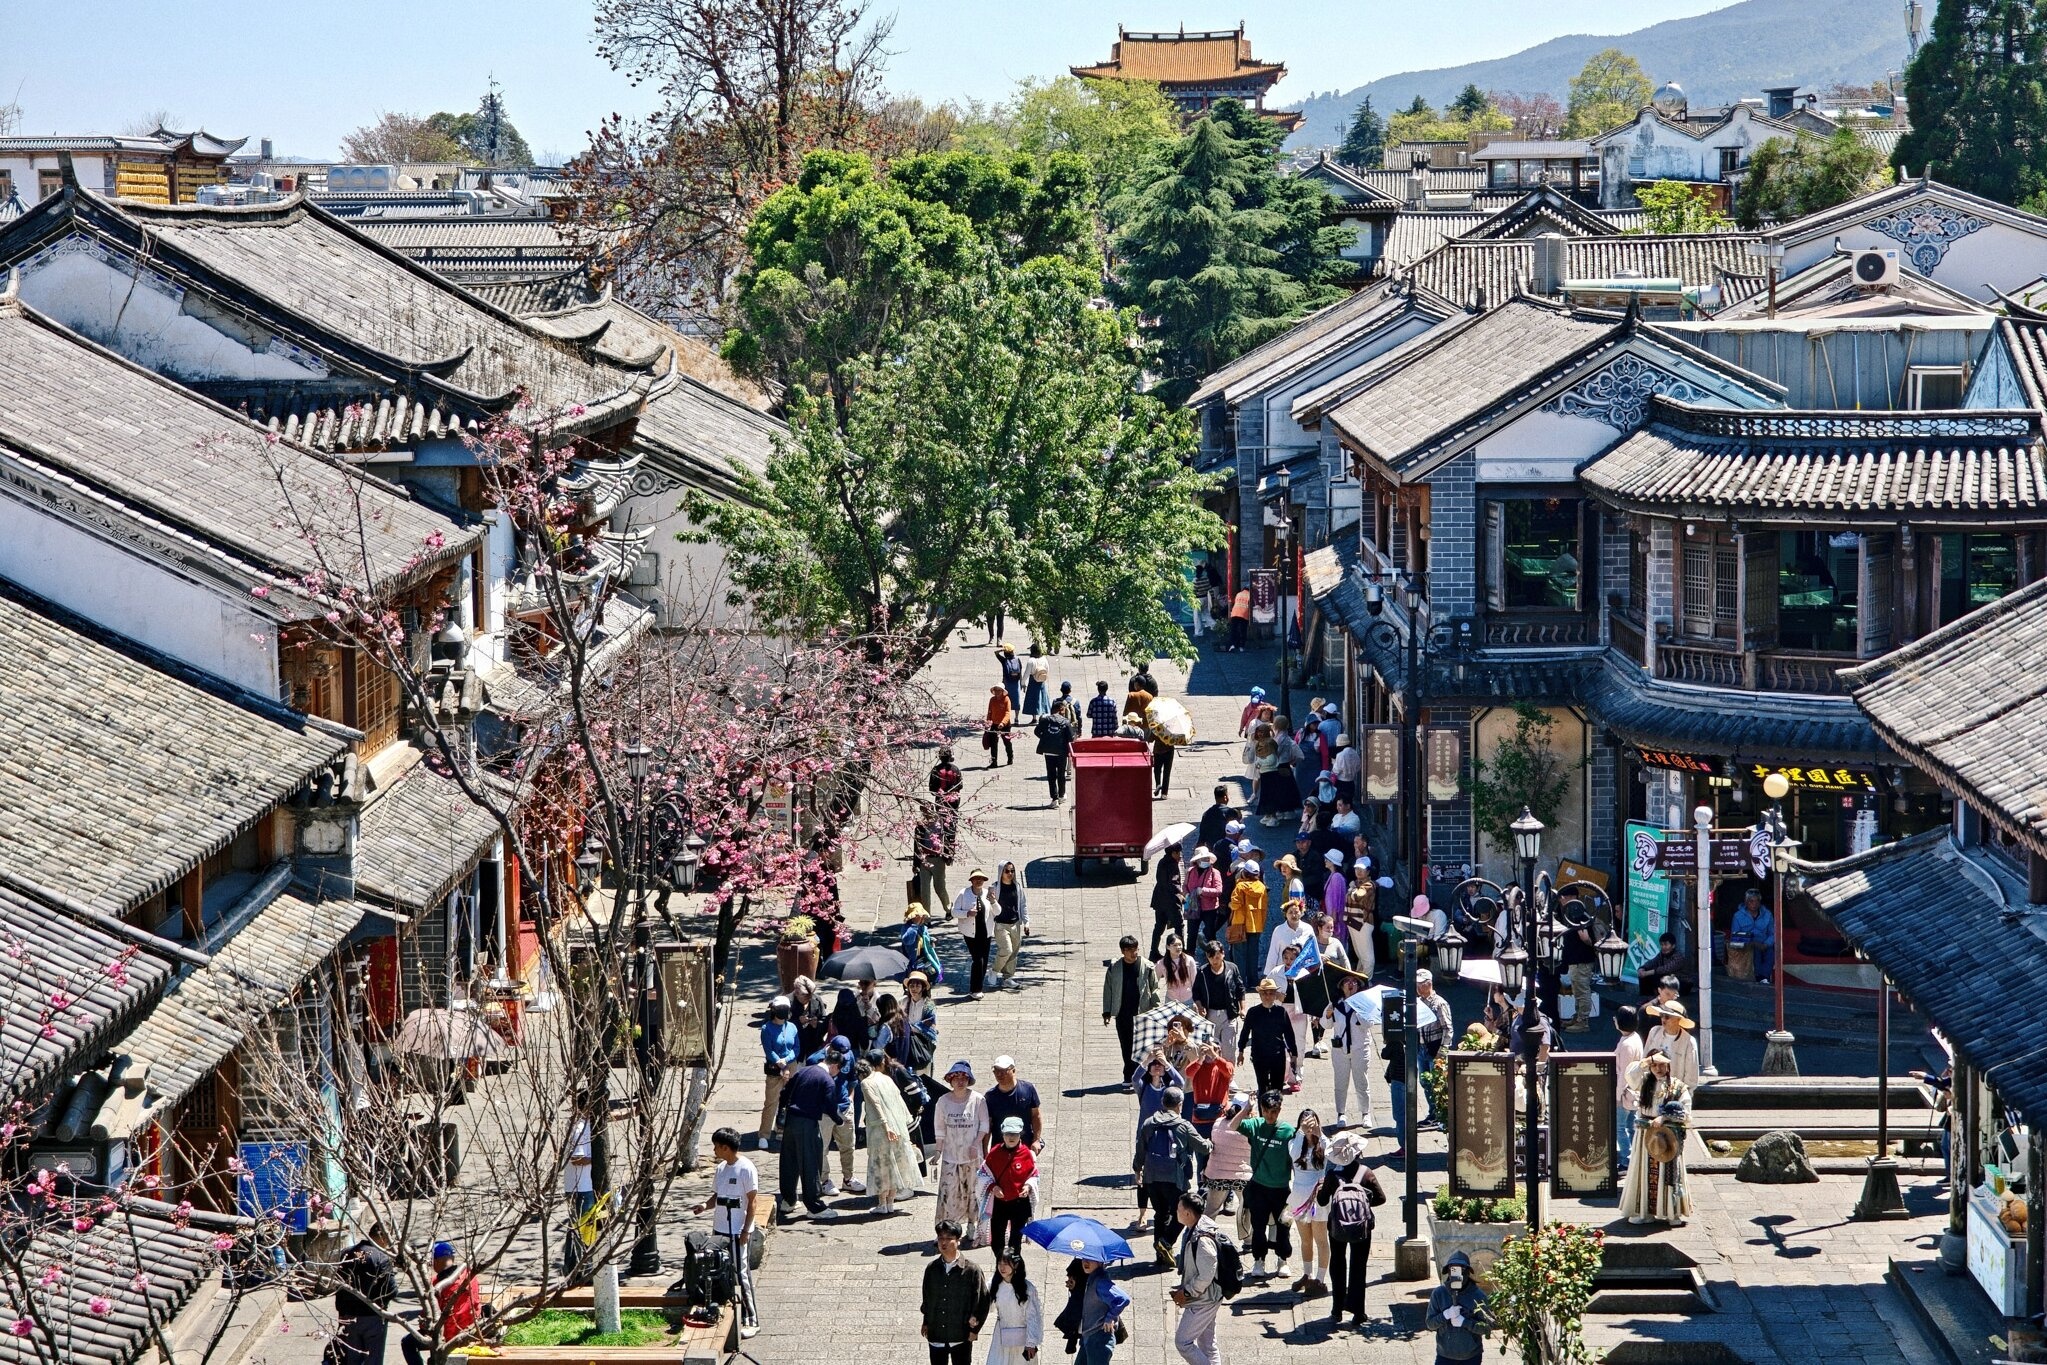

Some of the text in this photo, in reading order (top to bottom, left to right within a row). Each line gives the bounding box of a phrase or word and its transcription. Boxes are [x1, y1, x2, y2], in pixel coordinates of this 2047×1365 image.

[1482, 1085, 1492, 1145] 共建文明大理
